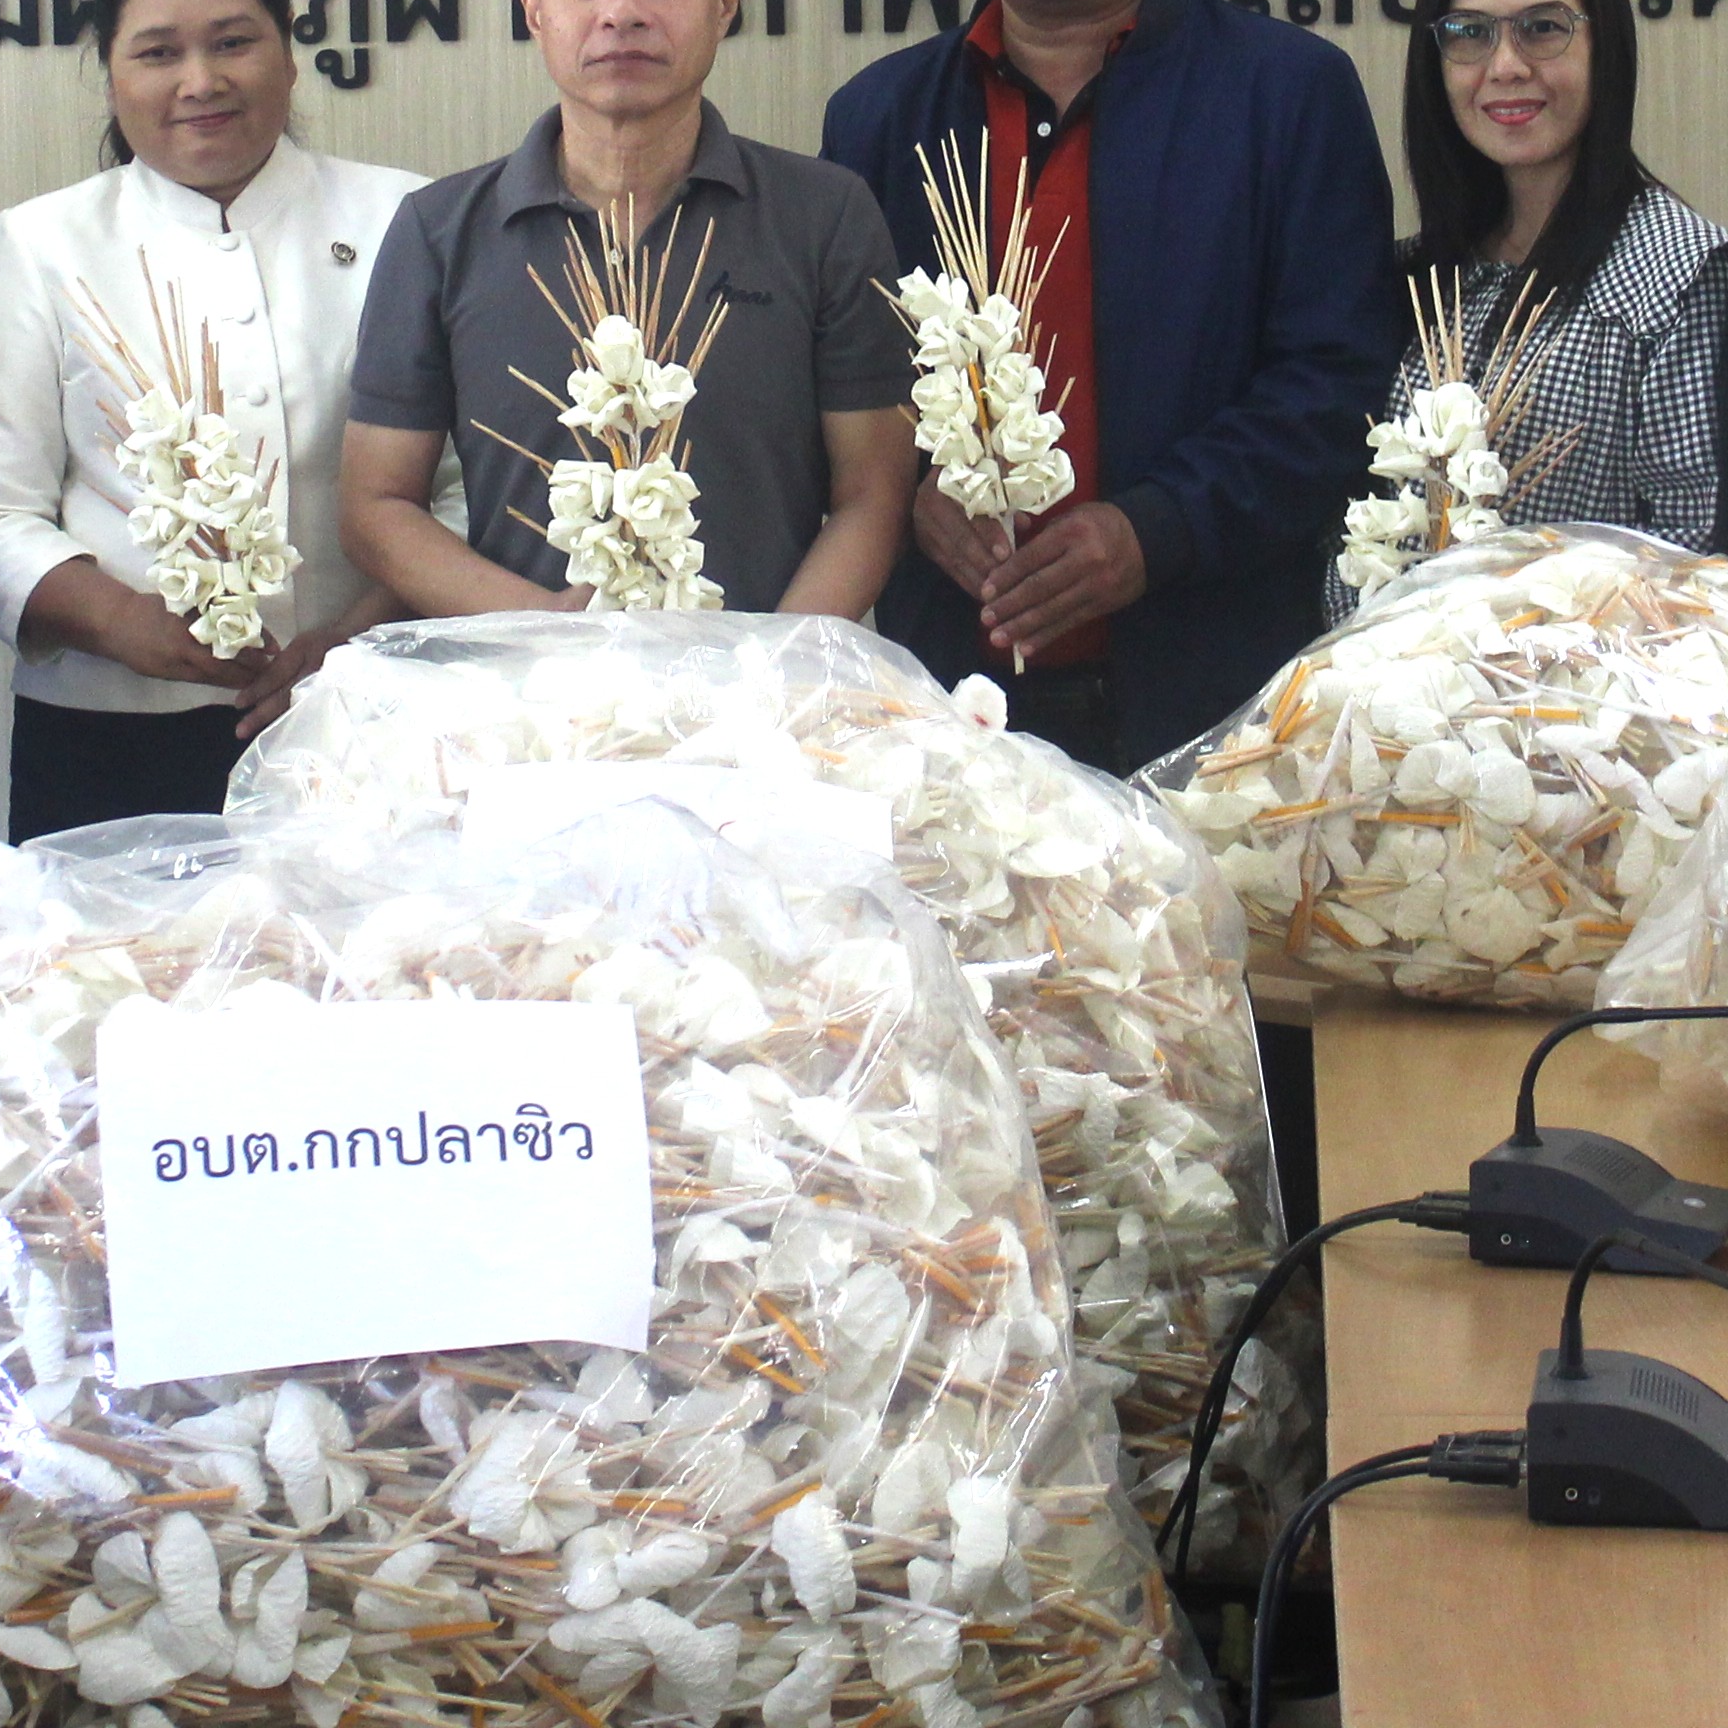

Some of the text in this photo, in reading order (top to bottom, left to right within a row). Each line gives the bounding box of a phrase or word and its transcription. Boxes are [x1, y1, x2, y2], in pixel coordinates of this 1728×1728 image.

[152, 1103, 594, 1182] อบต.กกปลาซิว
